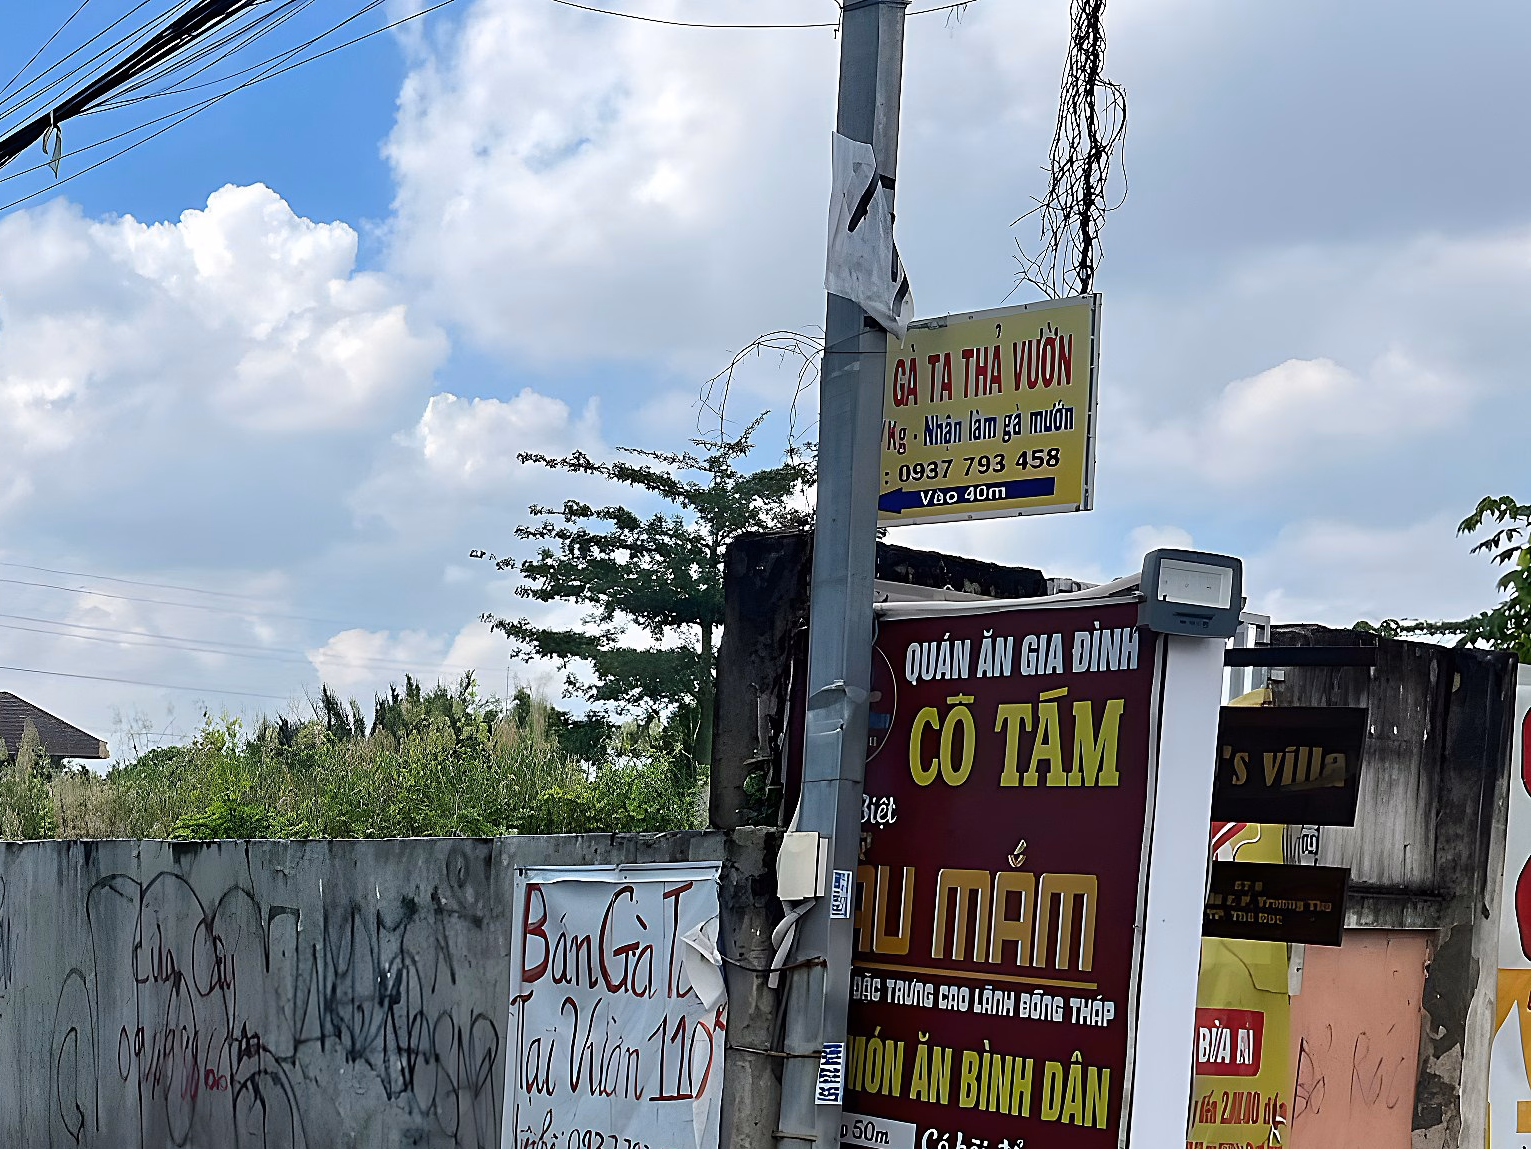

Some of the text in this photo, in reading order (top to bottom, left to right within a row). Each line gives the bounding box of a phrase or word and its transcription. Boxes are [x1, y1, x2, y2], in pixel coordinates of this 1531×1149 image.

[893, 322, 1073, 407] GÀ TA THẢ VƯỜN
[923, 414, 962, 451] Nhận
[969, 409, 997, 441] làm
[1002, 404, 1021, 443] gà
[899, 447, 1060, 482] 0937 793 458
[920, 485, 1006, 505] Vào 40m
[905, 621, 1139, 685] QUÁN ĂN GIA ĐÌNH
[995, 687, 1125, 786] TÁM
[1263, 747, 1346, 787] villa
[932, 839, 1097, 971] MẮM
[939, 985, 968, 1012] CAO
[1070, 995, 1115, 1026] THÁP
[847, 1026, 904, 1097] MÓN
[910, 1031, 952, 1105] ĂN
[959, 1039, 1033, 1117] BÌNH
[1041, 1050, 1110, 1129] DÂN
[852, 1120, 890, 1145] 50m
